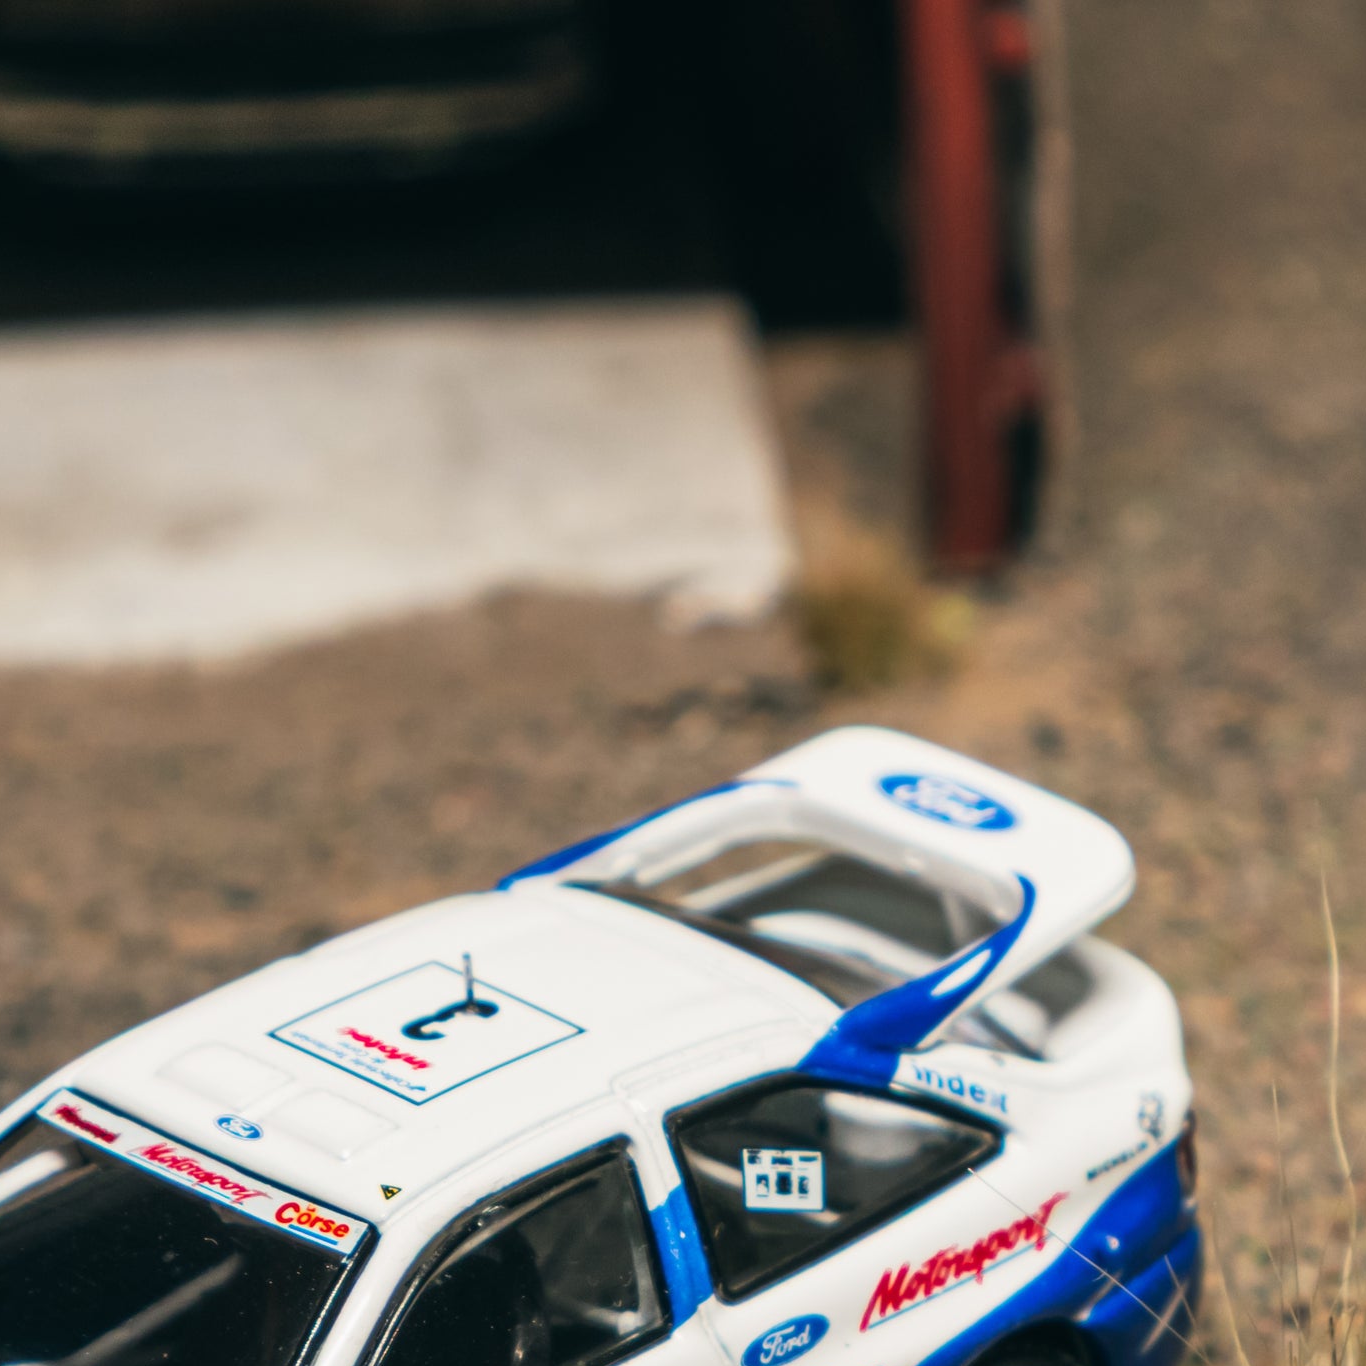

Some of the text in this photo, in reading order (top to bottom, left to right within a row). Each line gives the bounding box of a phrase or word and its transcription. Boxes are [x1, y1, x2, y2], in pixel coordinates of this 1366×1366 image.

[275, 1202, 350, 1239] Corse
[860, 1192, 1068, 1331] Motorsport
[760, 1324, 811, 1363] Ford
